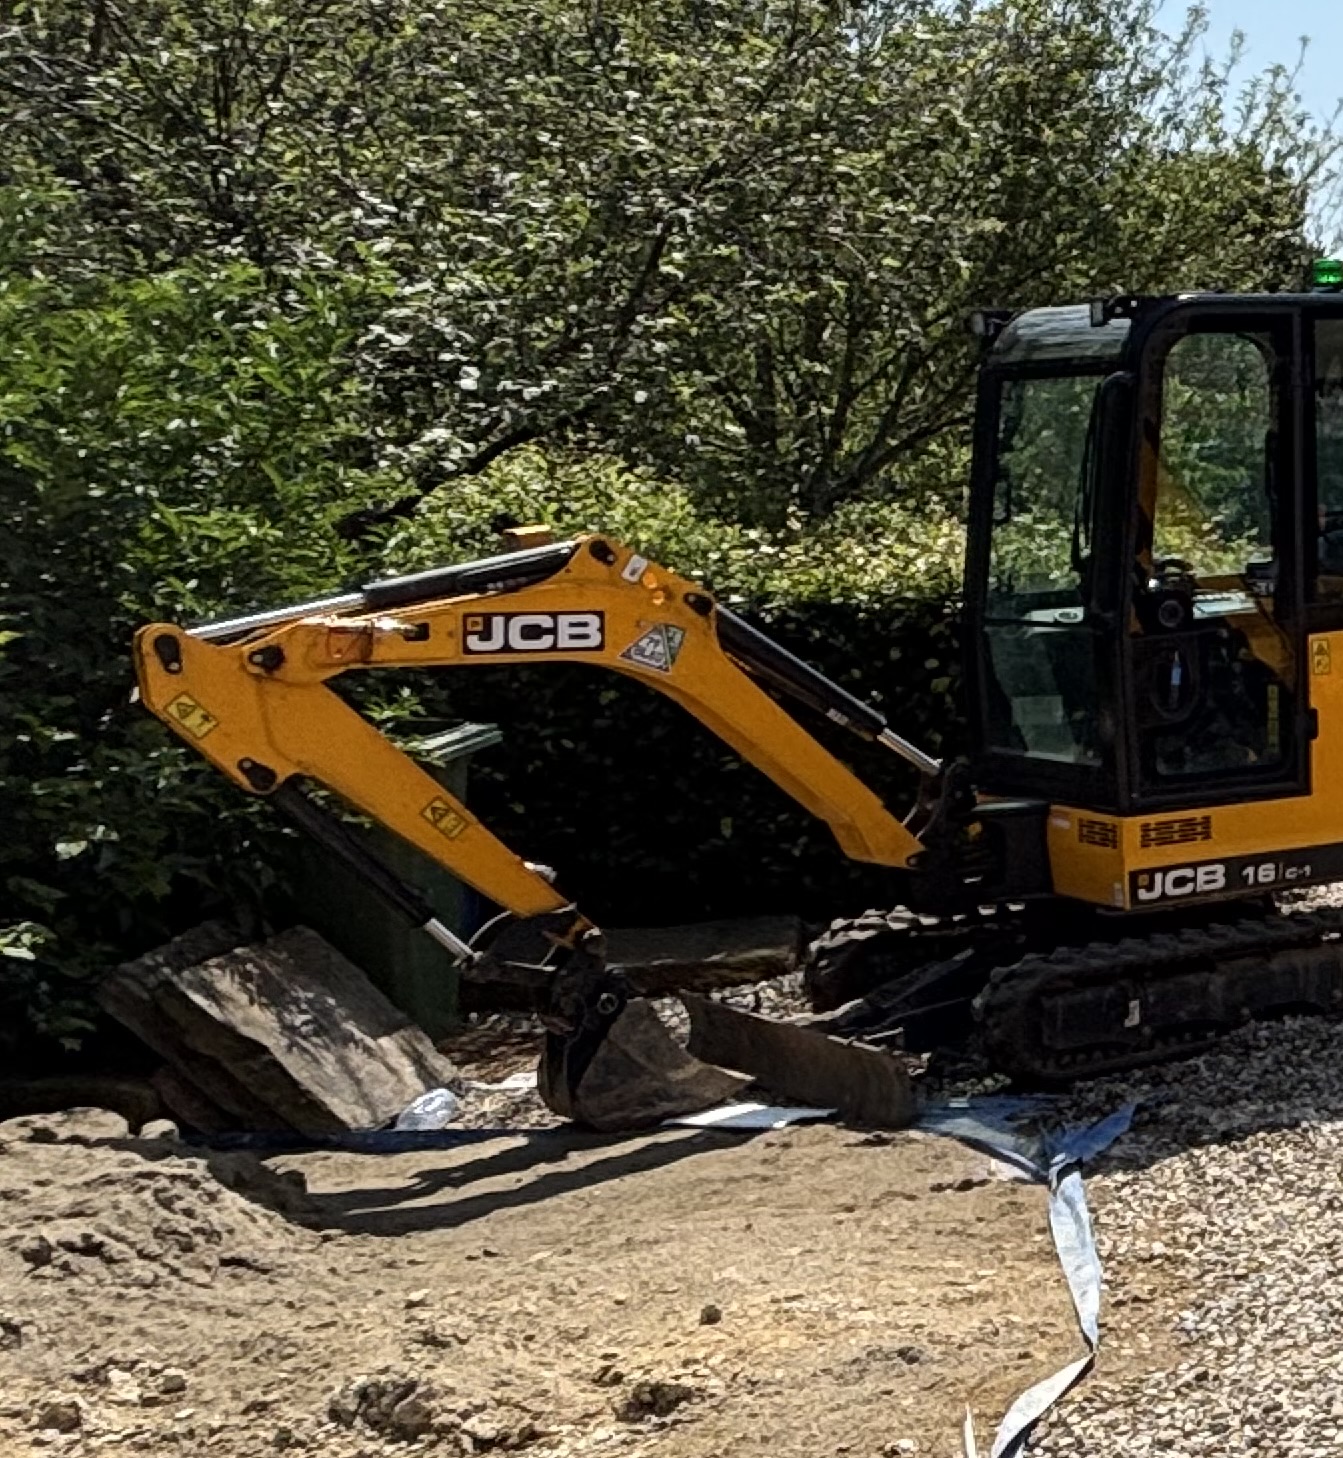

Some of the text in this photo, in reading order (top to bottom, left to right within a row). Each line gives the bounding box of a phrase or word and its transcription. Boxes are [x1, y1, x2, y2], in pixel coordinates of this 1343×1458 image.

[466, 614, 602, 651] JCB
[1137, 864, 1226, 900] JCB
[1241, 863, 1276, 885] 16
